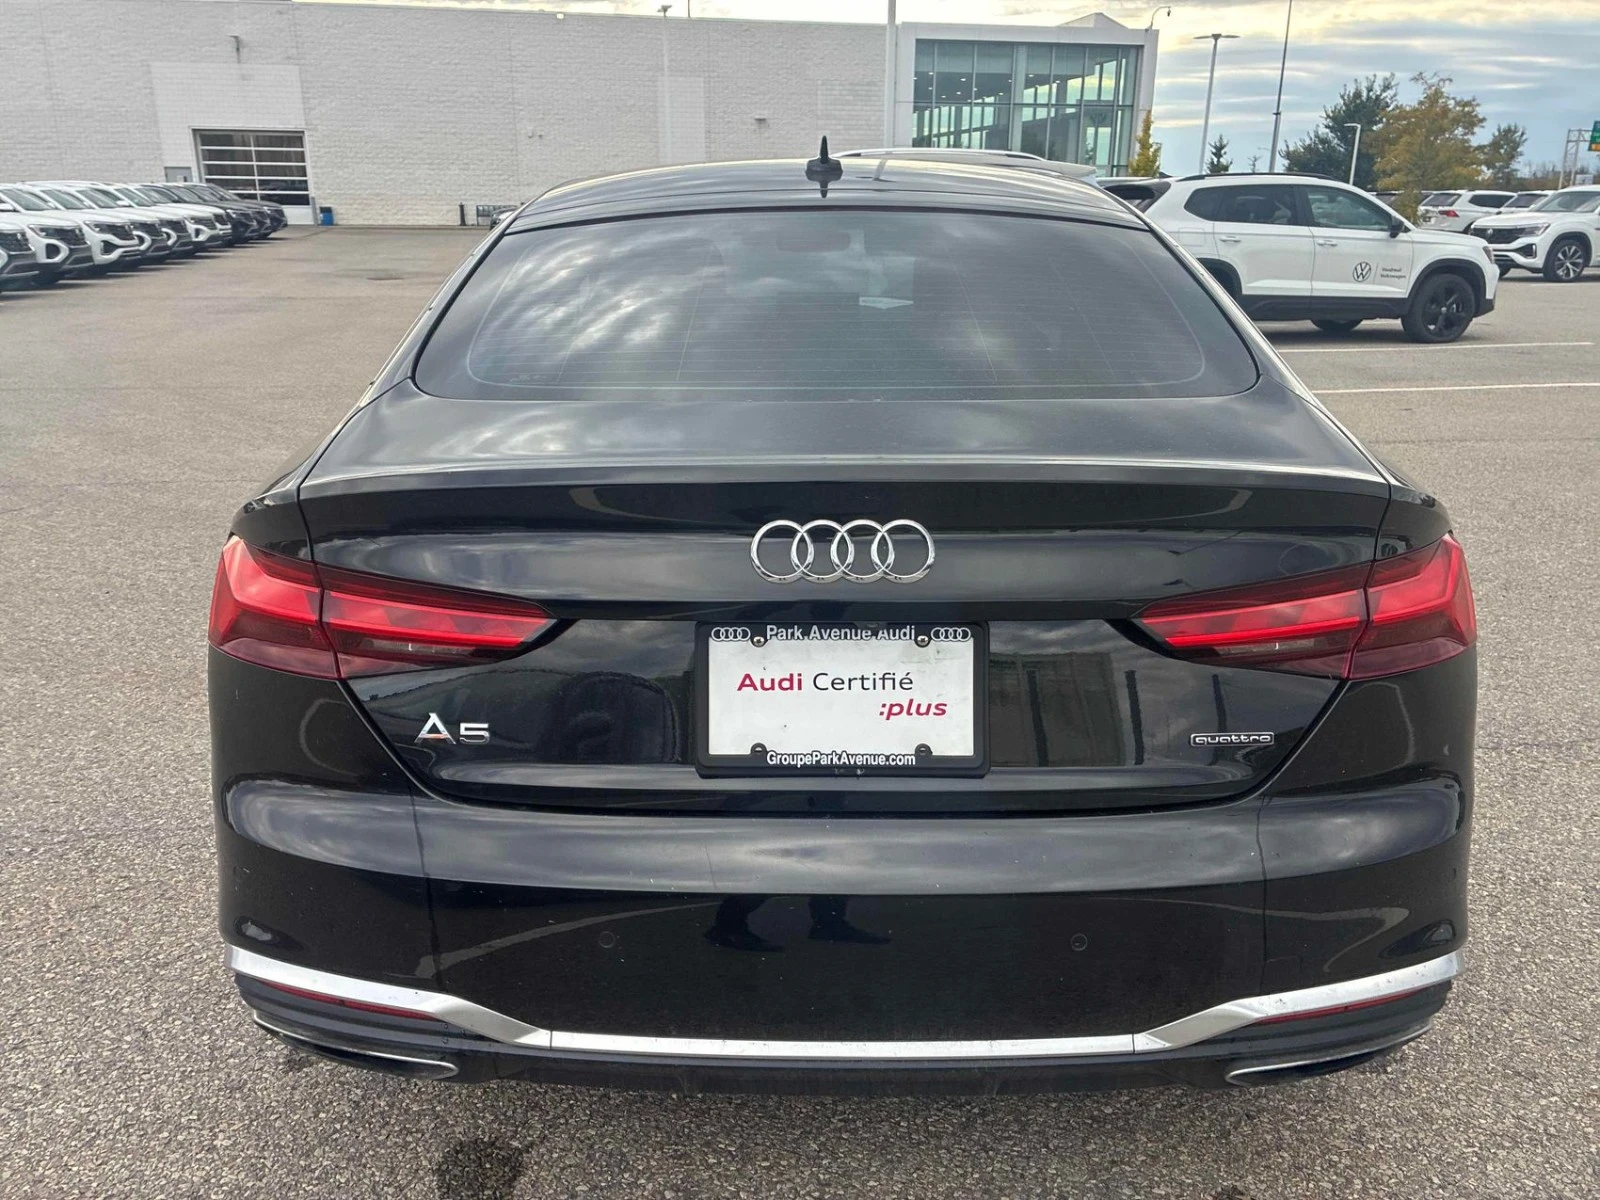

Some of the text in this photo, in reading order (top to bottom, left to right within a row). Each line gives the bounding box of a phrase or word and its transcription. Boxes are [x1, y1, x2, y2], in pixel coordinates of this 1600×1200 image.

[766, 625, 916, 641] Park Avenue Audi
[736, 671, 914, 691] Audi Certifié
[878, 698, 948, 721] :plus
[414, 712, 490, 745] A5
[1195, 734, 1271, 745] quattro
[766, 751, 916, 768] GroupeParkAvenue.com
